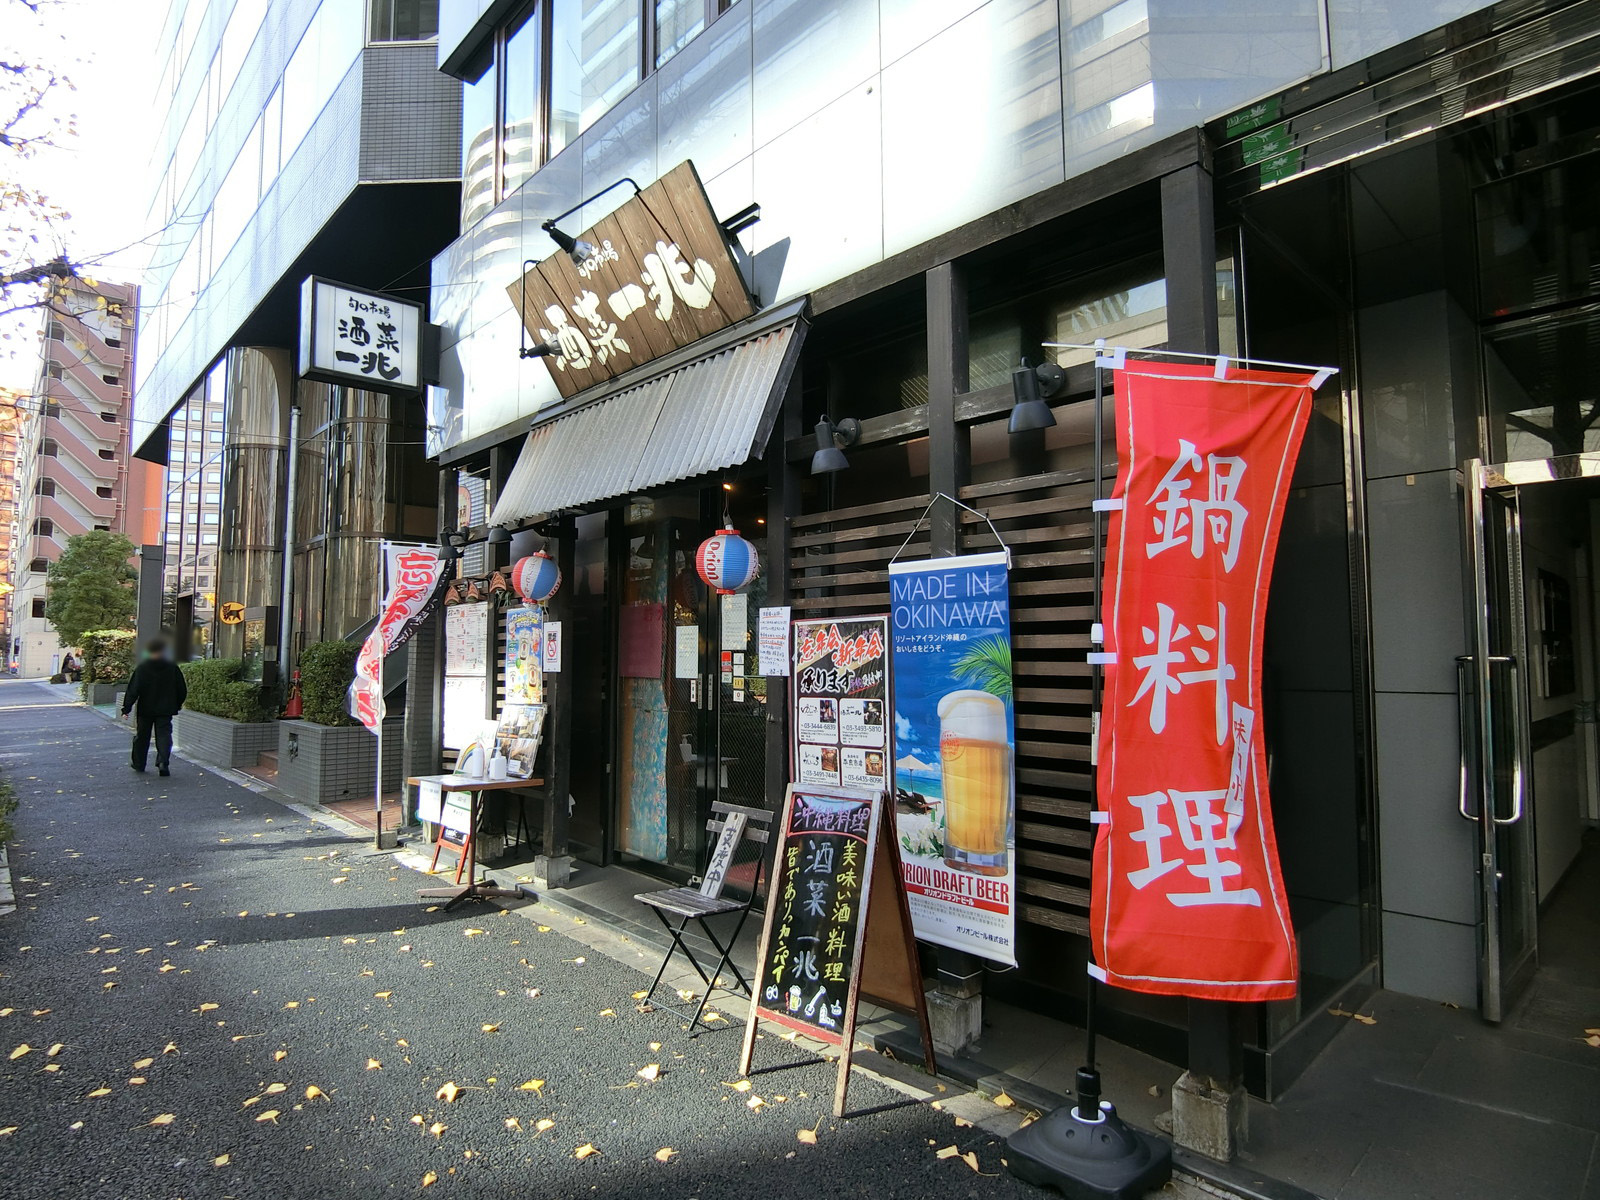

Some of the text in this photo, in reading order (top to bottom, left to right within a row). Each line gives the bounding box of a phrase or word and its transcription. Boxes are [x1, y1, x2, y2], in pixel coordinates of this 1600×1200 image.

[348, 296, 391, 319] 旬の市場
[539, 240, 717, 371] 酒菜一兆
[338, 316, 400, 353] 酒菜
[335, 350, 401, 380] 一兆
[706, 541, 721, 580] Orion
[893, 570, 990, 602] MADE IN
[894, 600, 1005, 629] OKINAWA
[895, 633, 967, 643] リゾートアイランド沖縄の
[1126, 438, 1262, 907] 鍋料理
[794, 798, 871, 833] 沖縄料理
[934, 868, 974, 896] DRAFT
[976, 878, 1009, 904] BEER
[792, 839, 834, 980] 酒菜一兆
